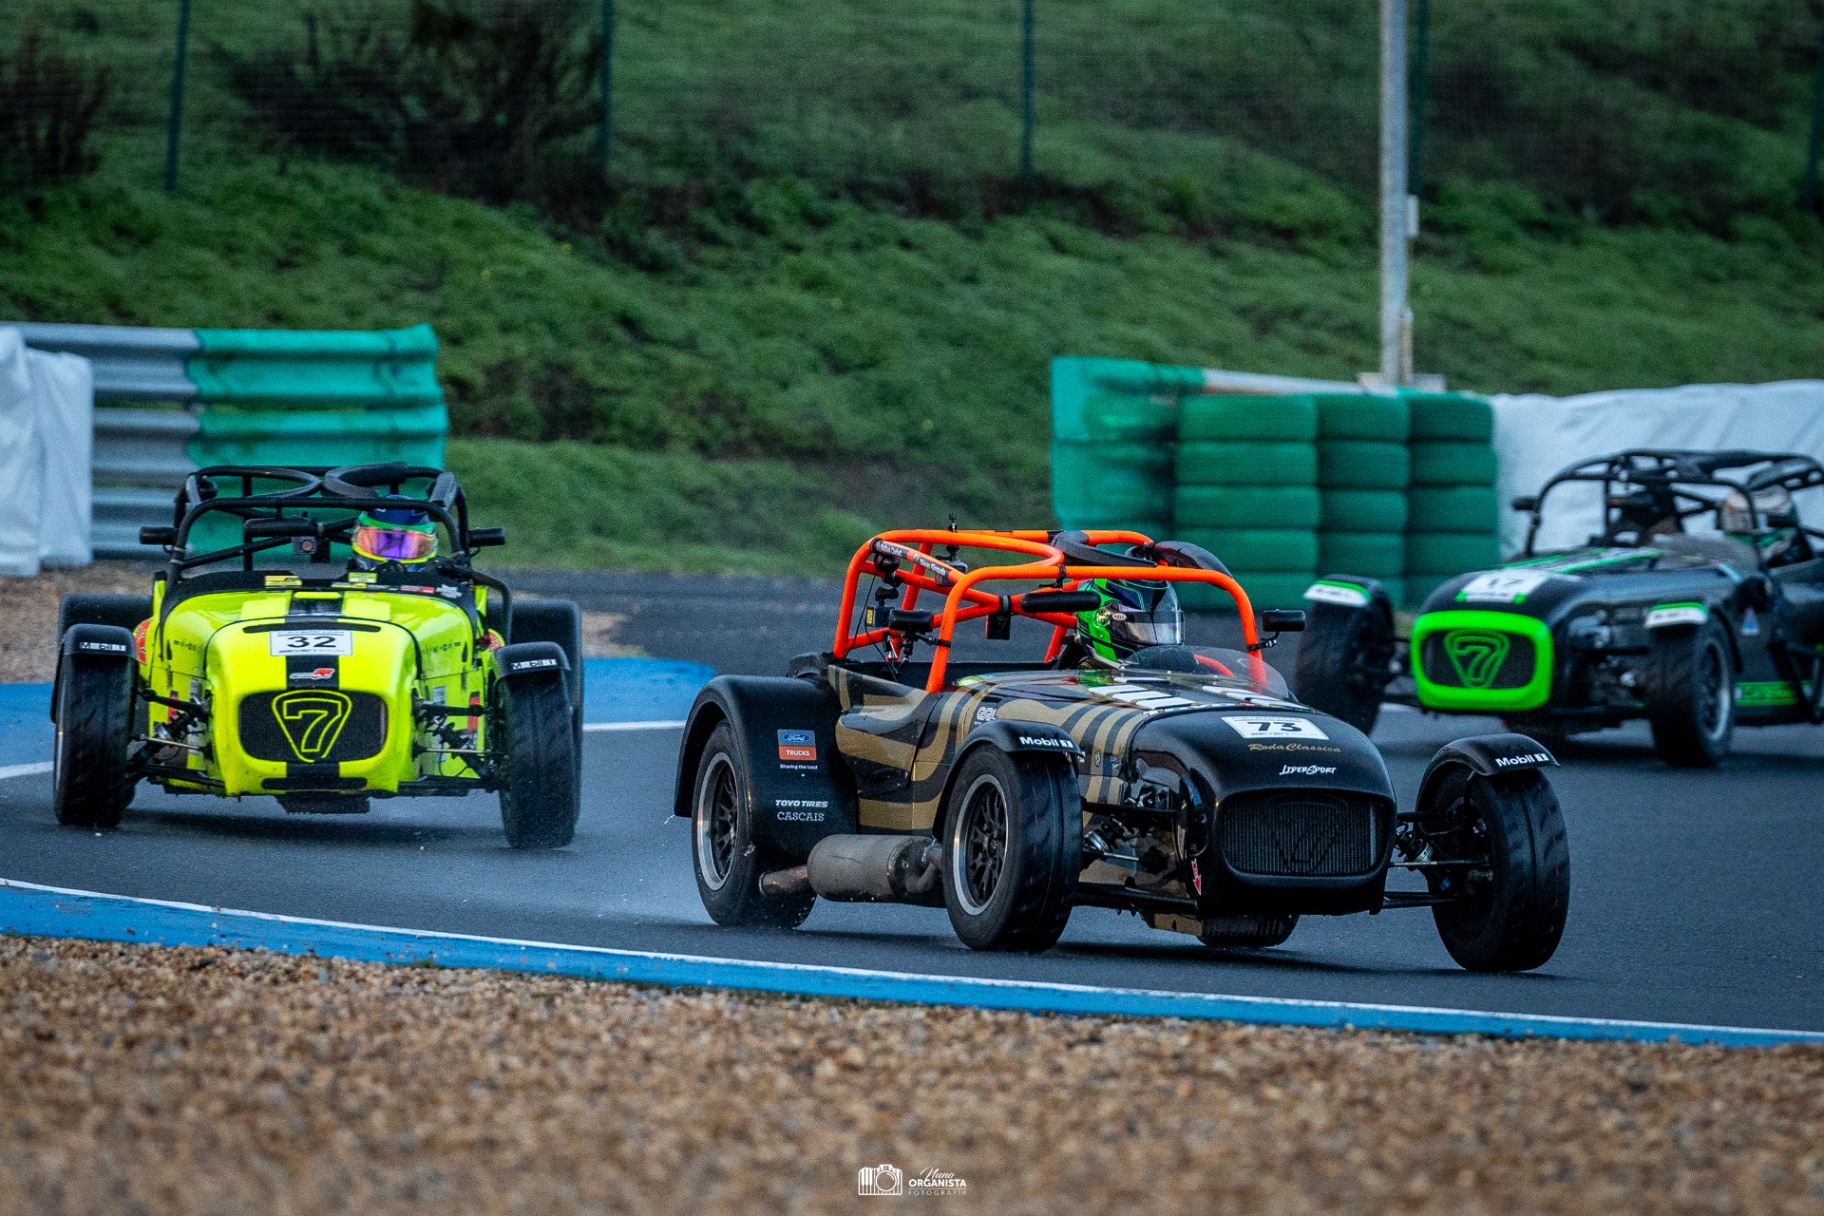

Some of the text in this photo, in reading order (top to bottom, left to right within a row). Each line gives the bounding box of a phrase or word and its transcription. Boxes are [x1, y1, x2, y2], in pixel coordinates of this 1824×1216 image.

[287, 635, 337, 648] 32
[283, 697, 342, 752] 7
[1247, 721, 1302, 732] 73
[787, 733, 806, 741] Ford
[1019, 736, 1059, 748] Mobil
[1248, 743, 1341, 753] Roda Classica
[1495, 754, 1535, 767] Mobil
[775, 799, 828, 808] TOYO TIRES
[777, 811, 825, 822] CASCAIS
